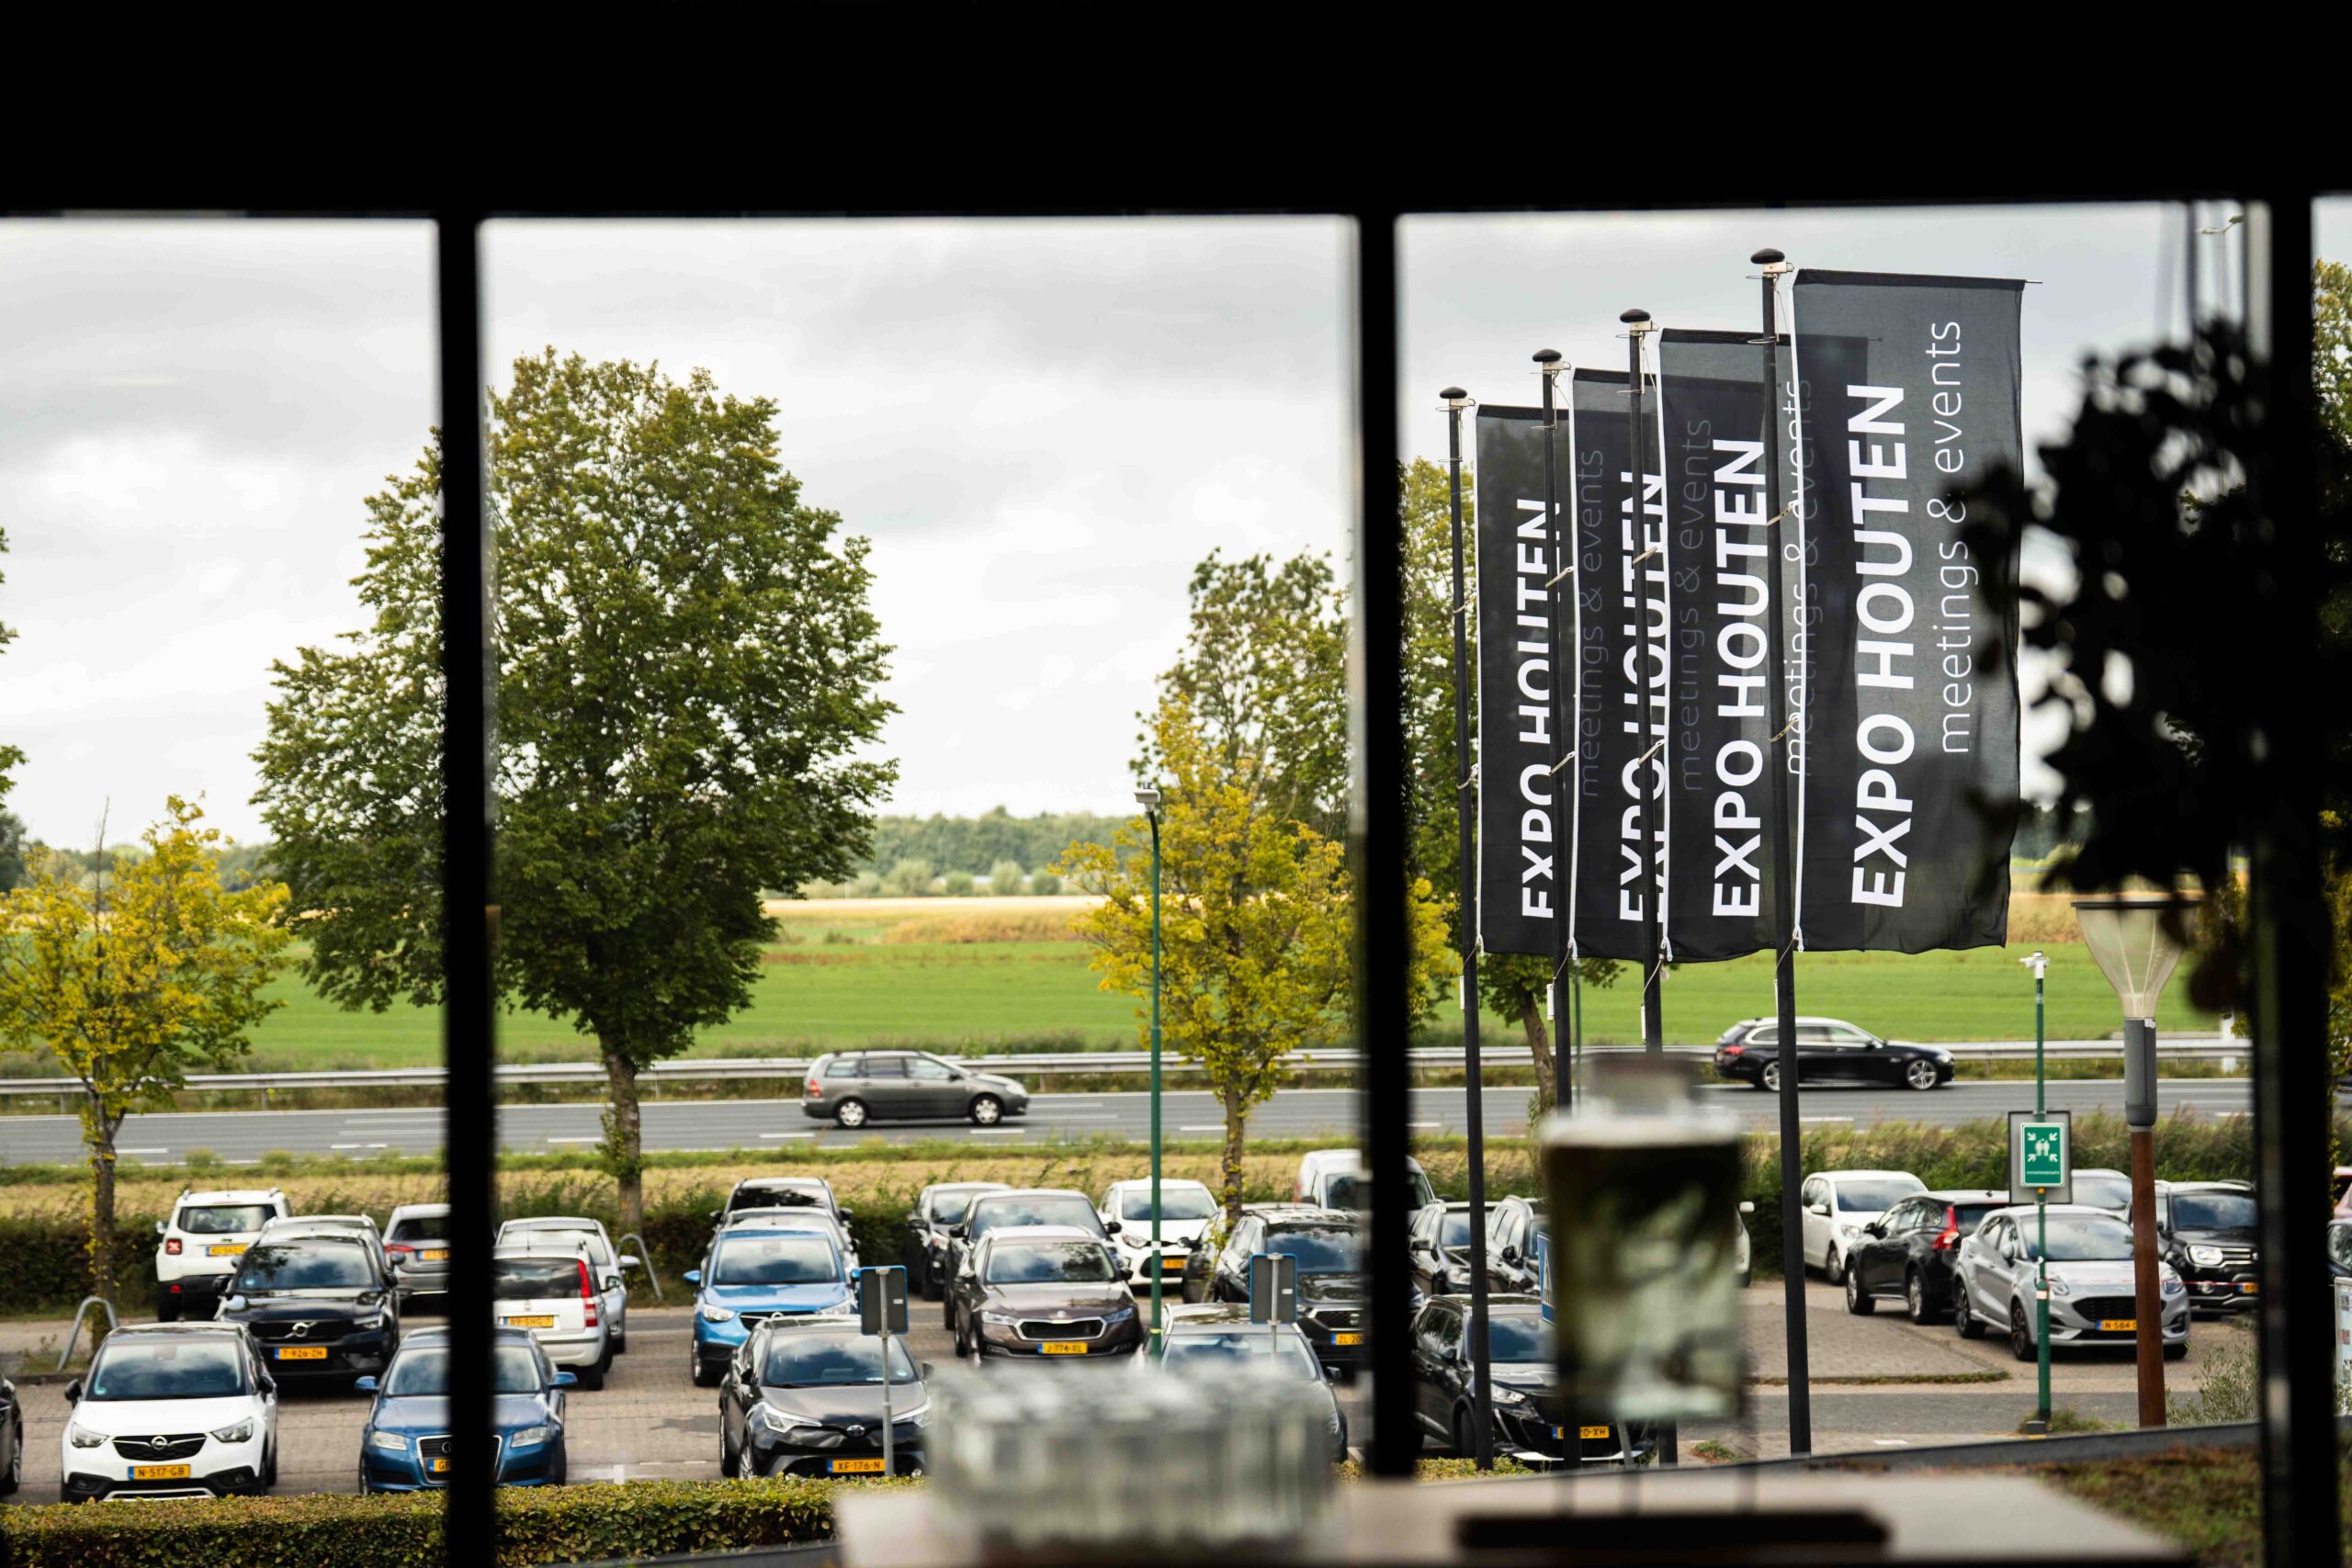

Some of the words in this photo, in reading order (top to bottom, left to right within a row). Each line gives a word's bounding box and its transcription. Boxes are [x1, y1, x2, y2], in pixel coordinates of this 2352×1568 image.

[1925, 321, 1964, 473] events
[1577, 449, 1603, 571] events
[1679, 419, 1712, 549] events
[1847, 385, 1915, 690] HOUTEN
[1927, 498, 1966, 524] &
[1579, 585, 1602, 612] &
[1675, 565, 1701, 593] &
[1713, 439, 1770, 717] HOUTEN
[1932, 541, 1978, 752] meetings
[1575, 626, 1608, 796] meetings
[1679, 607, 1705, 791] meetings
[1713, 739, 1764, 917] EXPO
[1851, 714, 1915, 908] EXPO
[138, 1467, 185, 1477] N-517-GB
[837, 1461, 881, 1472] XF-176-N
